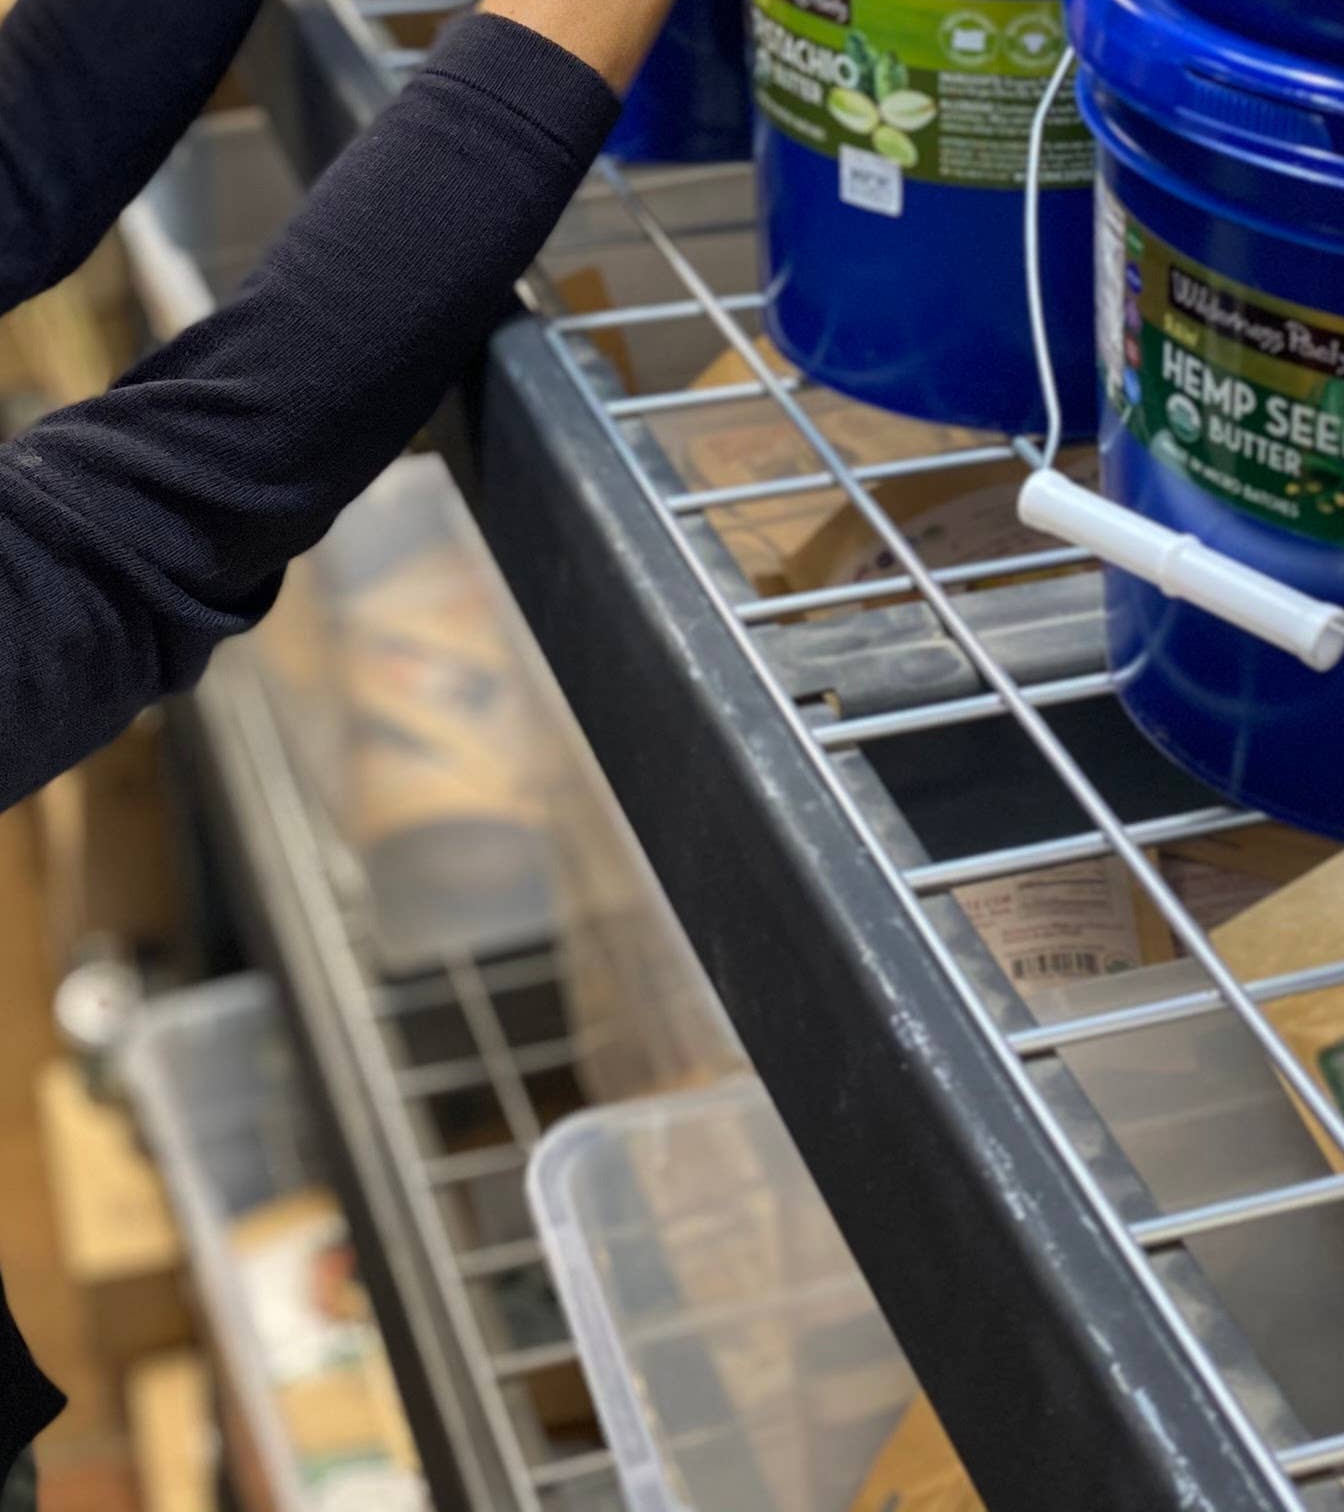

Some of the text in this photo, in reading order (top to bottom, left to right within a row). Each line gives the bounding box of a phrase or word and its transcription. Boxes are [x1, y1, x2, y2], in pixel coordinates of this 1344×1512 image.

[1171, 271, 1285, 355] Wilderness
[1162, 341, 1257, 421] HEMP
[1209, 415, 1303, 478] BUTTER
